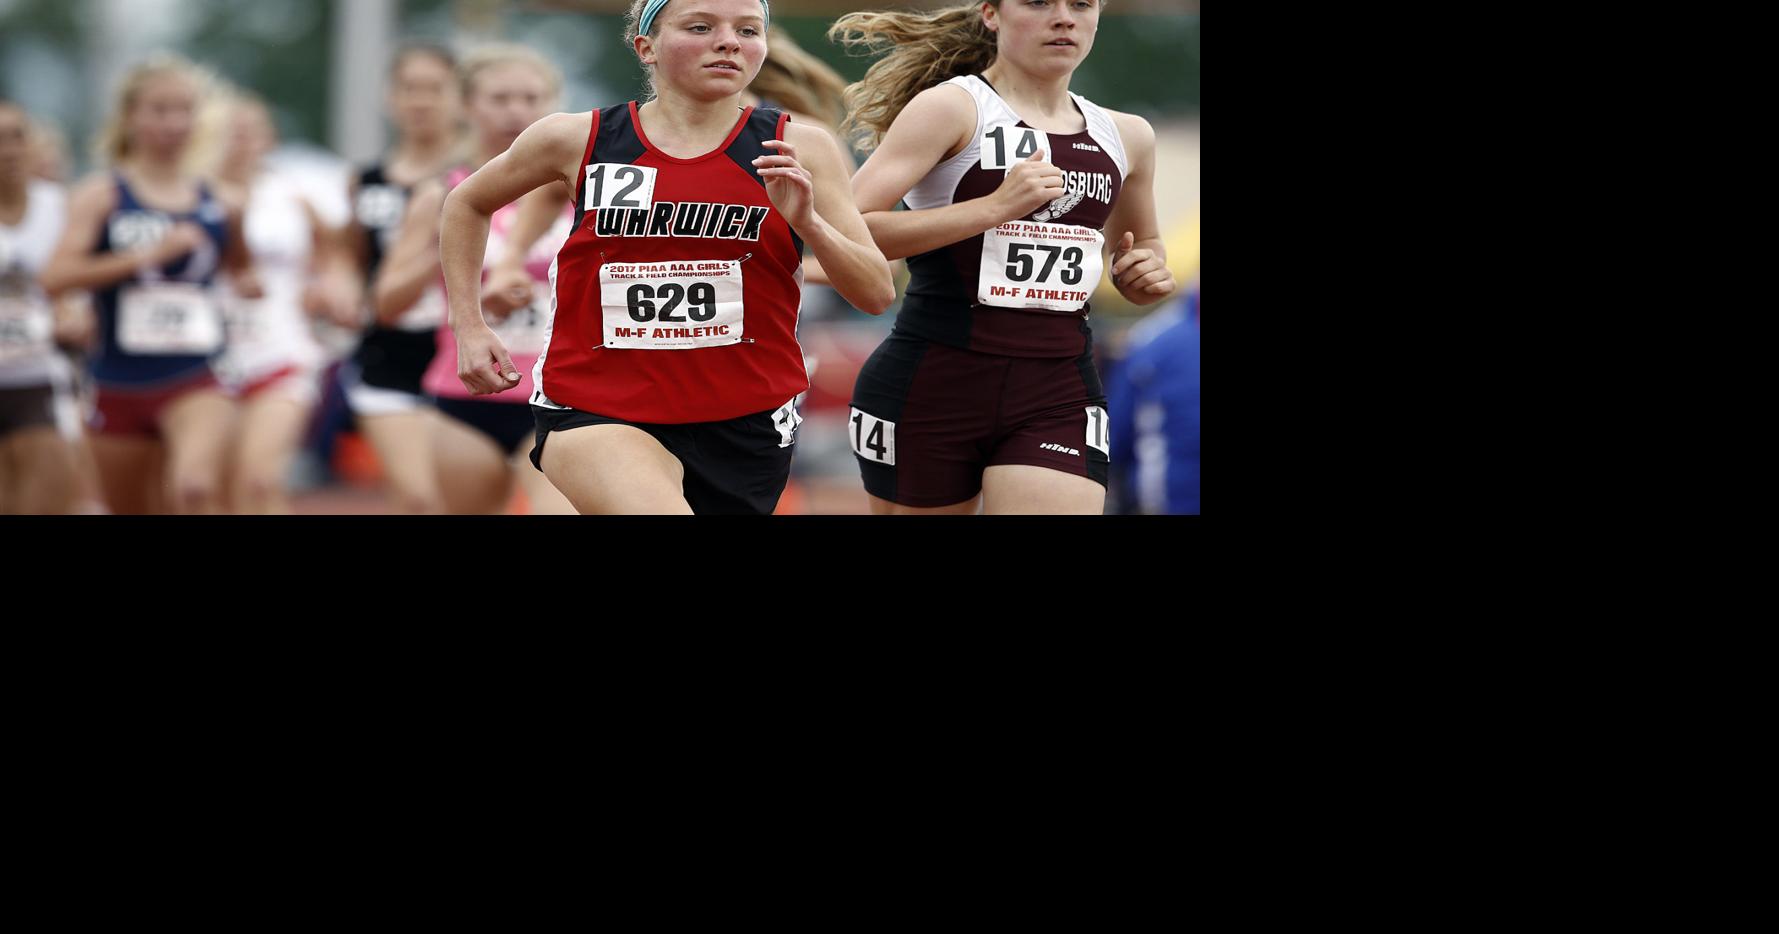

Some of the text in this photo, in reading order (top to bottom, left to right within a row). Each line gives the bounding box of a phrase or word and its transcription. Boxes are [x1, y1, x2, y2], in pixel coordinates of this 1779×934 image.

[985, 126, 1038, 167] 14
[589, 165, 644, 207] 12
[1061, 169, 1112, 204] DSBURG
[595, 201, 769, 241] WARWICK
[1023, 225, 1048, 233] PIAA
[1073, 228, 1096, 236] GIRLS
[670, 263, 694, 271] AAA
[697, 262, 730, 271] GIRLS
[1005, 243, 1084, 286] 573
[626, 282, 717, 322] 629
[990, 286, 1088, 301] M-F ATHLETIC
[615, 325, 730, 338] M-F ATHLETIC
[852, 412, 887, 460] 14
[1091, 408, 1109, 451] 1
